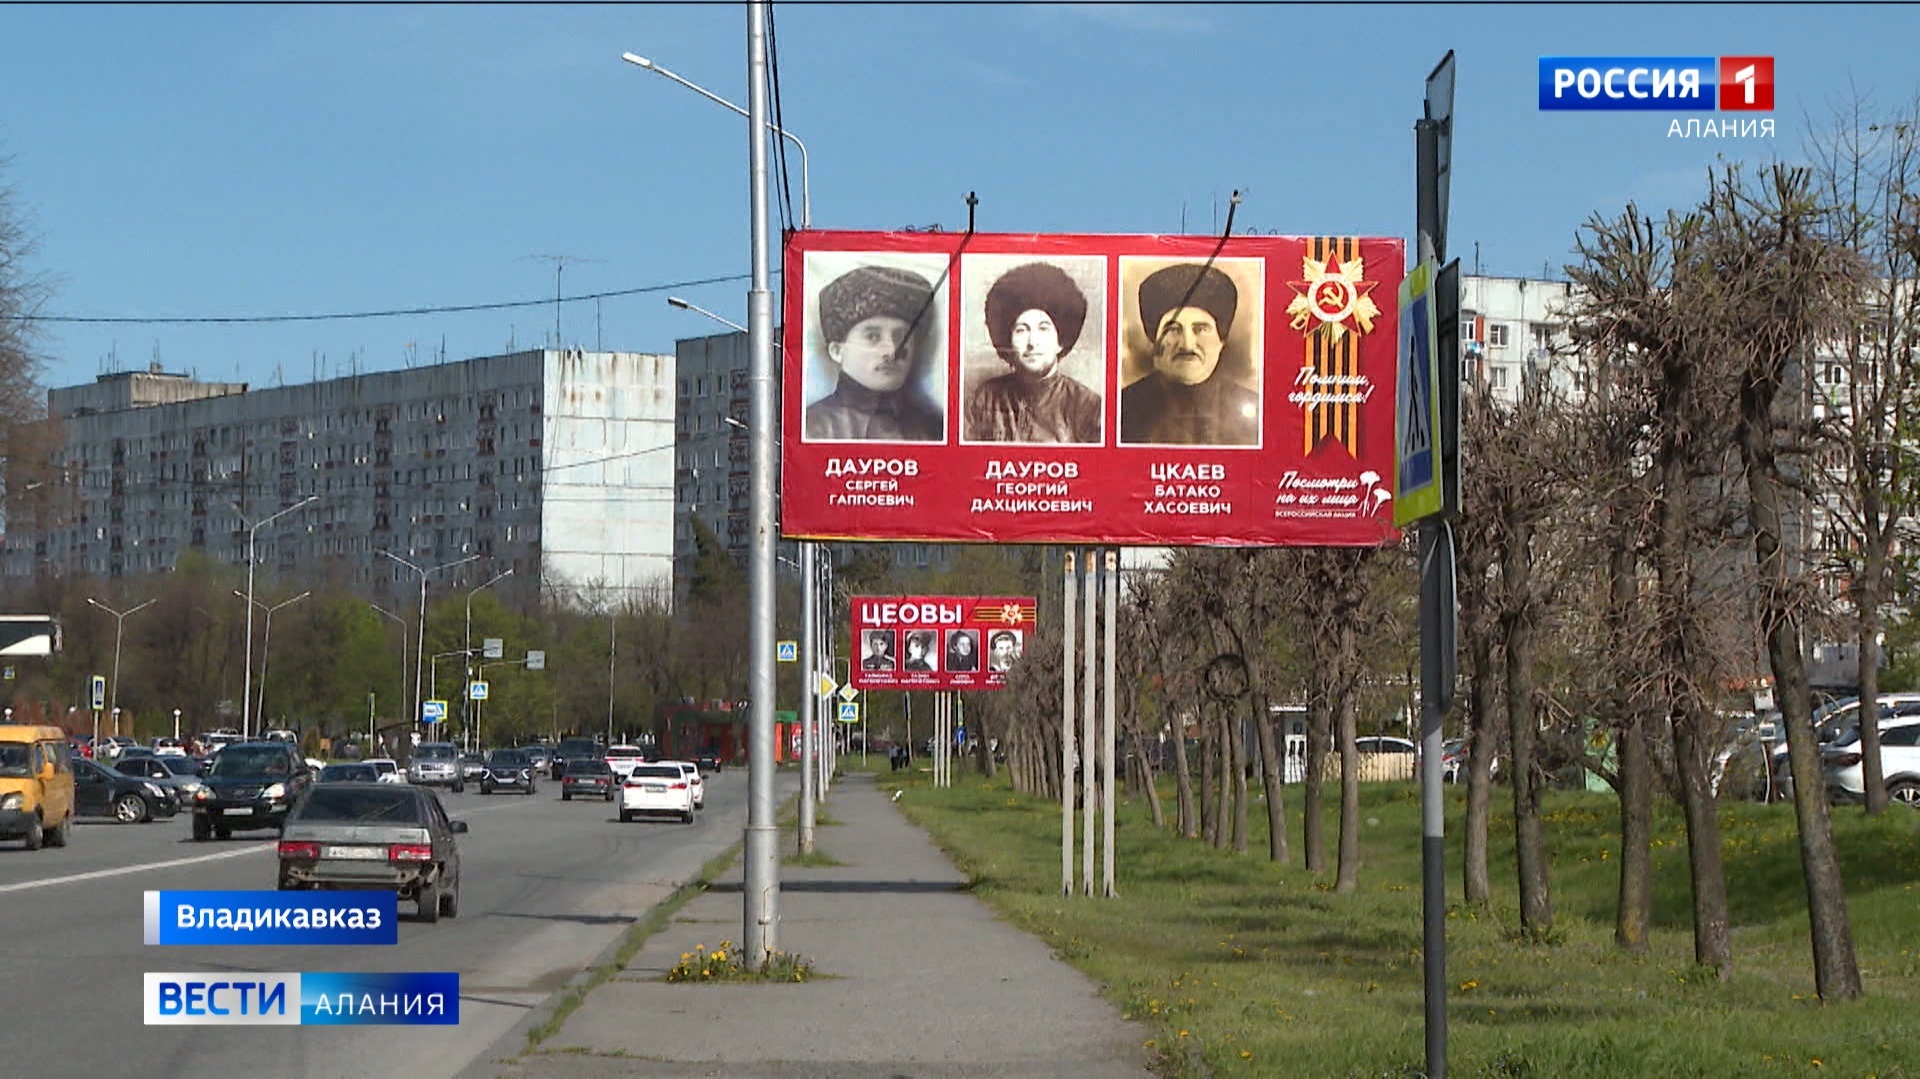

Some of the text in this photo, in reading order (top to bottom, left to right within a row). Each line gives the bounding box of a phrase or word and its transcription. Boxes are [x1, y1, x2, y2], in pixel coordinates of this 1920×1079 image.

[1294, 366, 1369, 387] Помним,
[1288, 384, 1375, 411] гордимся!
[825, 458, 919, 477] ДАУРОВ
[985, 460, 1079, 479] ДАУРОВ
[1150, 463, 1226, 482] ЦКАЕВ
[845, 478, 898, 491] СЕРГЕЙ
[996, 481, 1068, 495] ГЕОРГИЙ
[1278, 470, 1359, 493] Посмотри
[1154, 485, 1221, 498] БАТАКО
[1276, 493, 1359, 507] на их лица
[829, 494, 914, 507] ГАППОЕВИЧ
[970, 498, 1093, 514] ДАХЦИКОЕВИЧ
[1144, 501, 1231, 515] ХАСОЕВИЧ
[861, 602, 962, 627] ЦЕОВЫ
